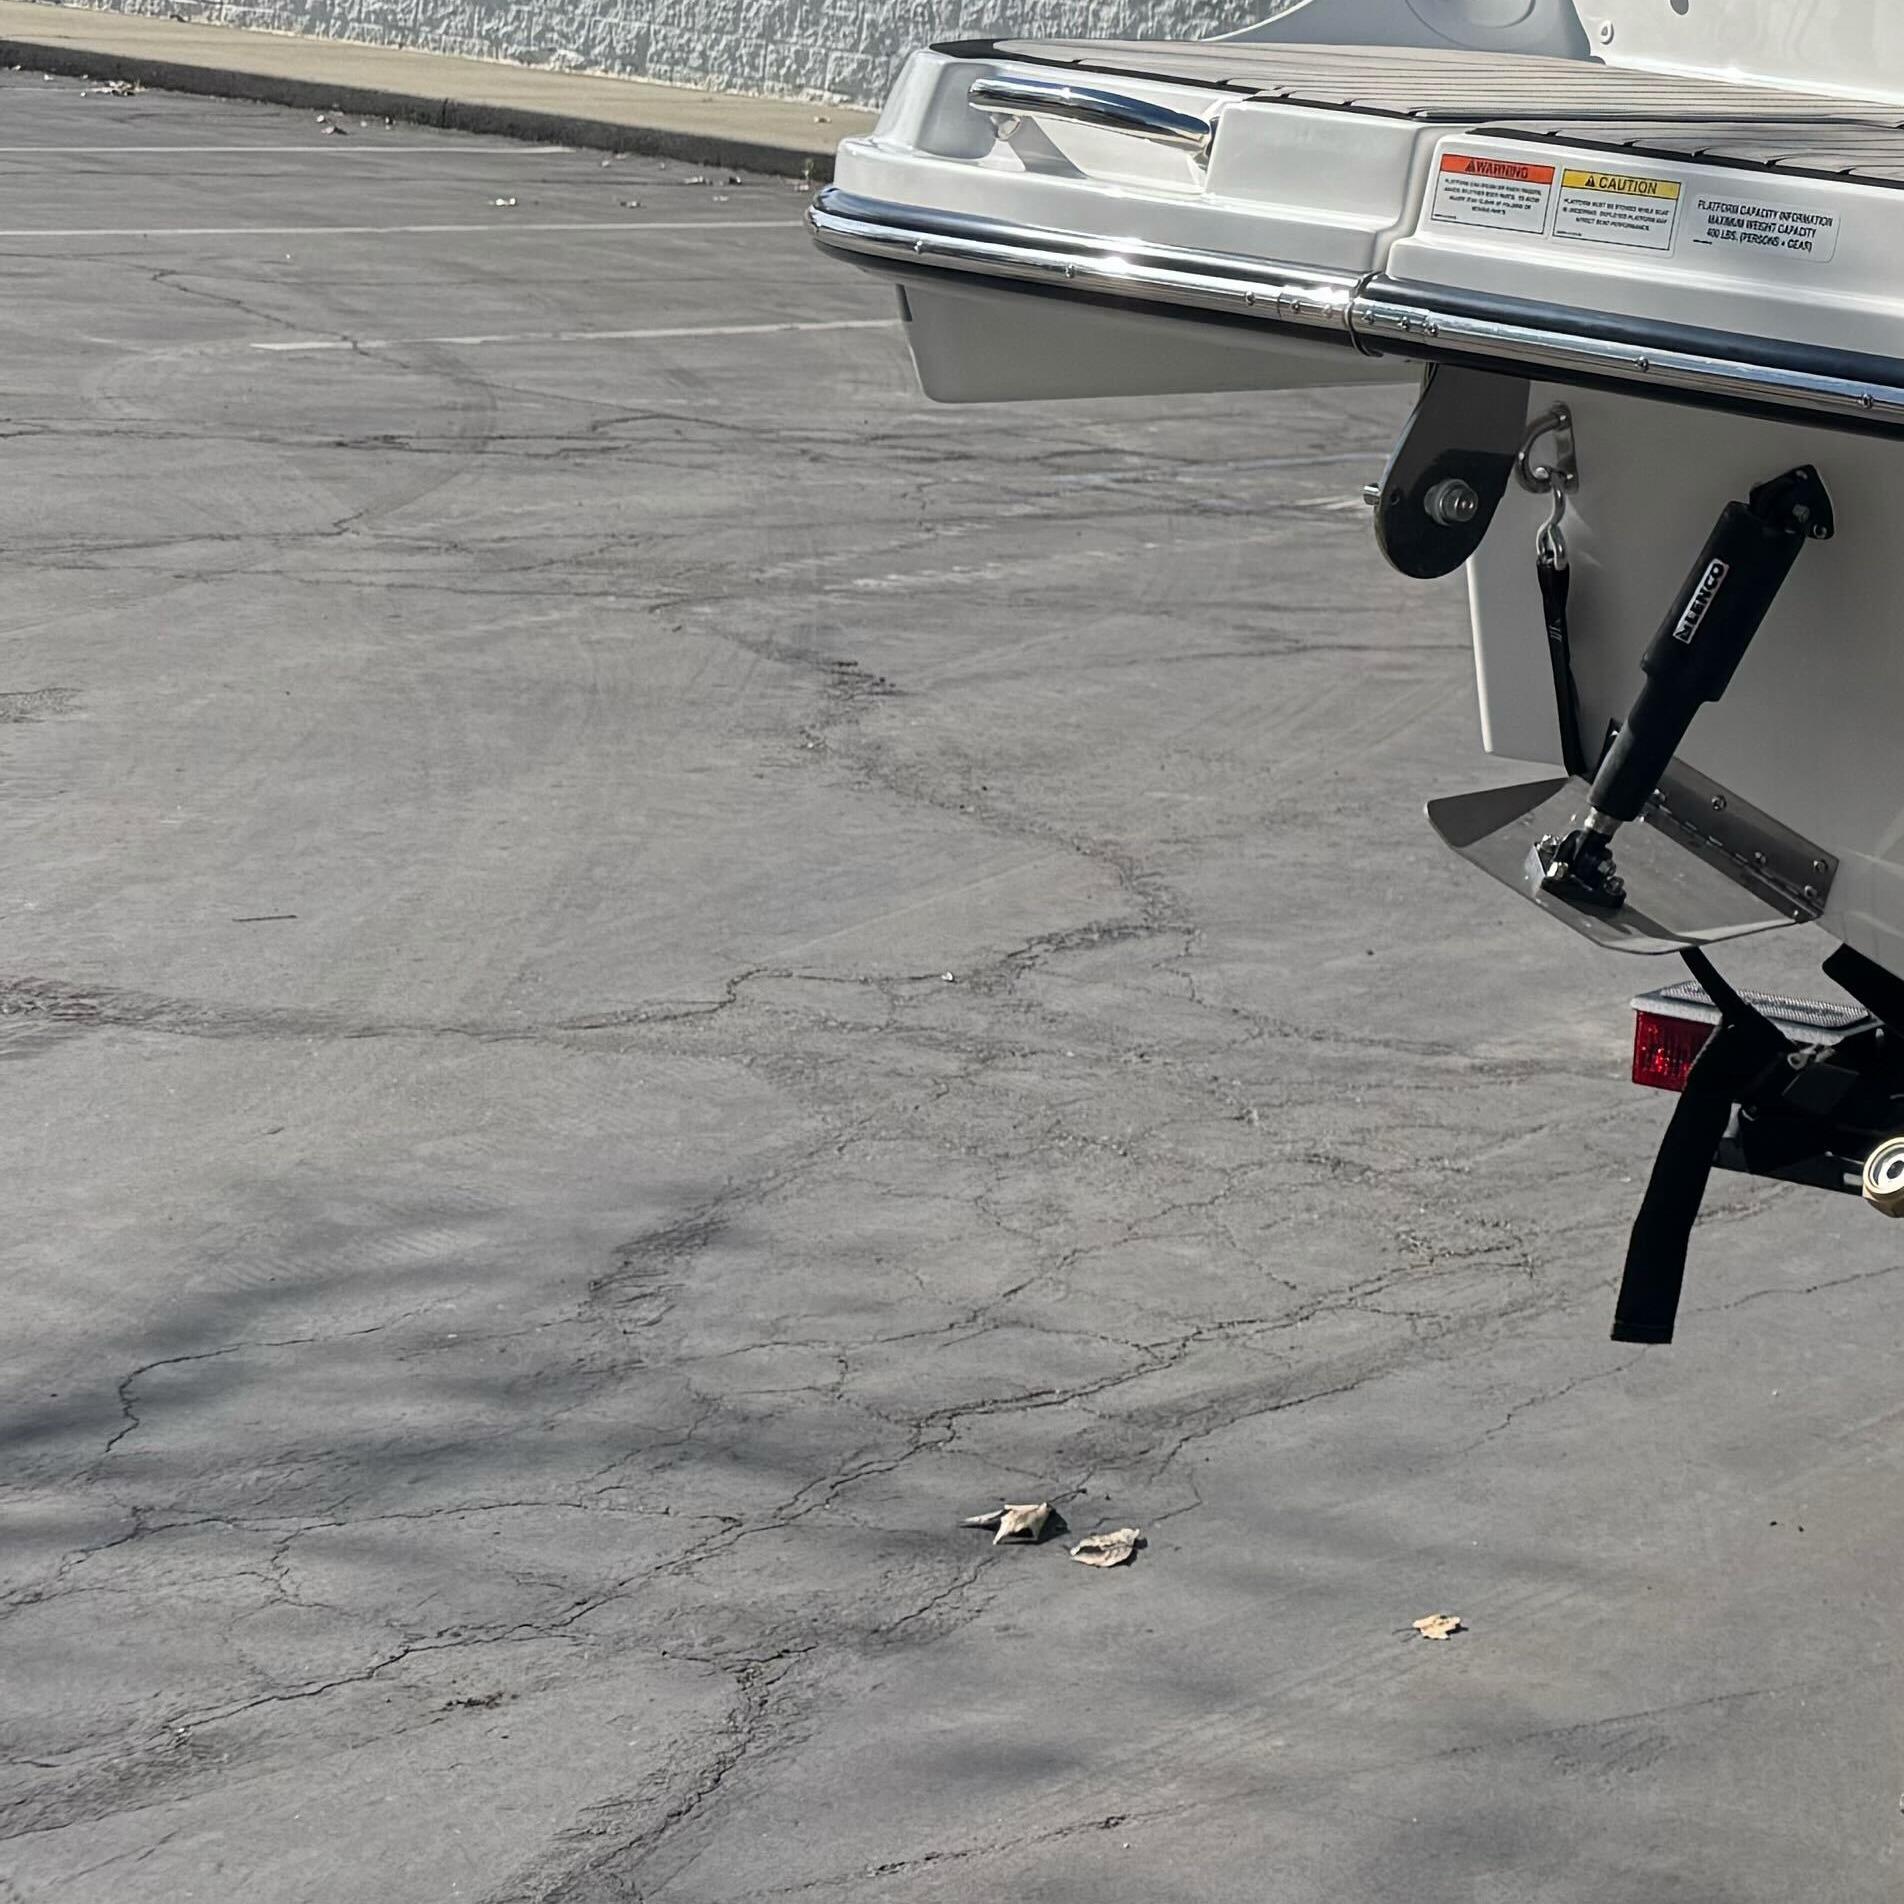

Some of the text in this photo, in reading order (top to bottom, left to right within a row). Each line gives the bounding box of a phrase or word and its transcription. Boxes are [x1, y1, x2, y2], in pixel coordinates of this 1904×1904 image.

[1474, 161, 1529, 180] WARNING
[1599, 176, 1658, 195] CAUTION
[1684, 562, 1724, 625] LENCO
